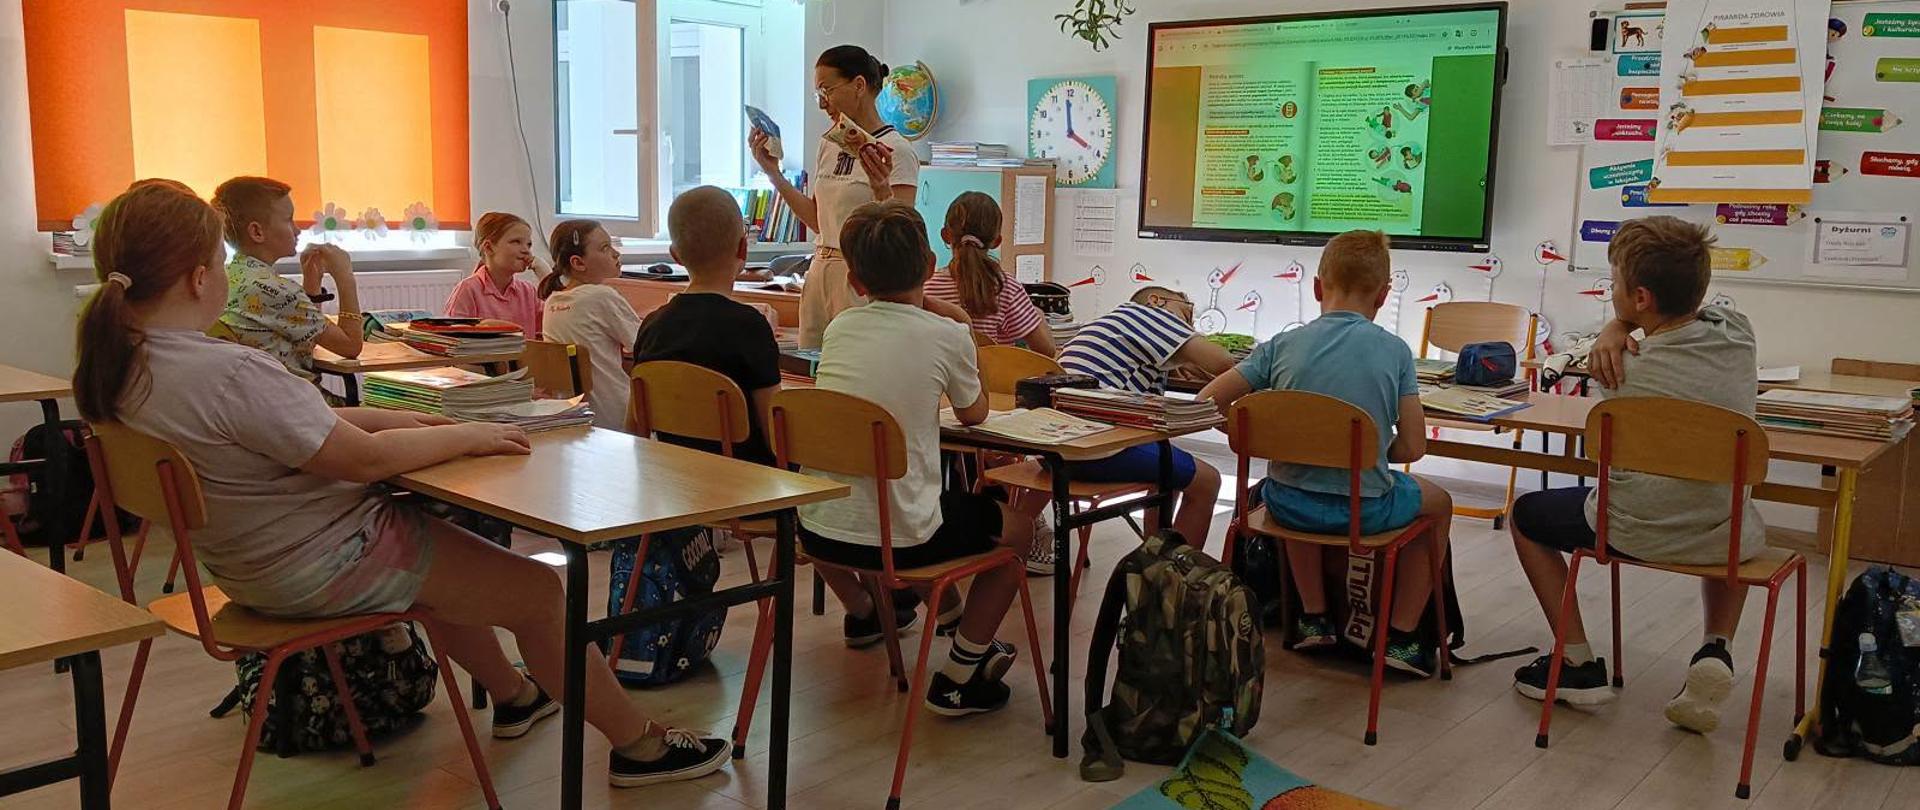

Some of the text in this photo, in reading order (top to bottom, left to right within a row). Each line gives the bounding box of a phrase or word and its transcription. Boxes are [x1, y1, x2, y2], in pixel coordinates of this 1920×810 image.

[1750, 10, 1785, 19] ZDROWIA
[1066, 88, 1075, 98] 12
[1051, 95, 1058, 104] 11
[1085, 94, 1089, 102] 1
[1039, 109, 1048, 119] 10
[1096, 108, 1101, 118] 2
[1037, 129, 1042, 139] 9
[1100, 129, 1105, 138] 3
[1041, 149, 1046, 159] 8
[1095, 149, 1101, 158] 4
[1084, 164, 1089, 173] 5
[1068, 170, 1073, 179] 6
[1831, 225, 1872, 234] Dyżurni
